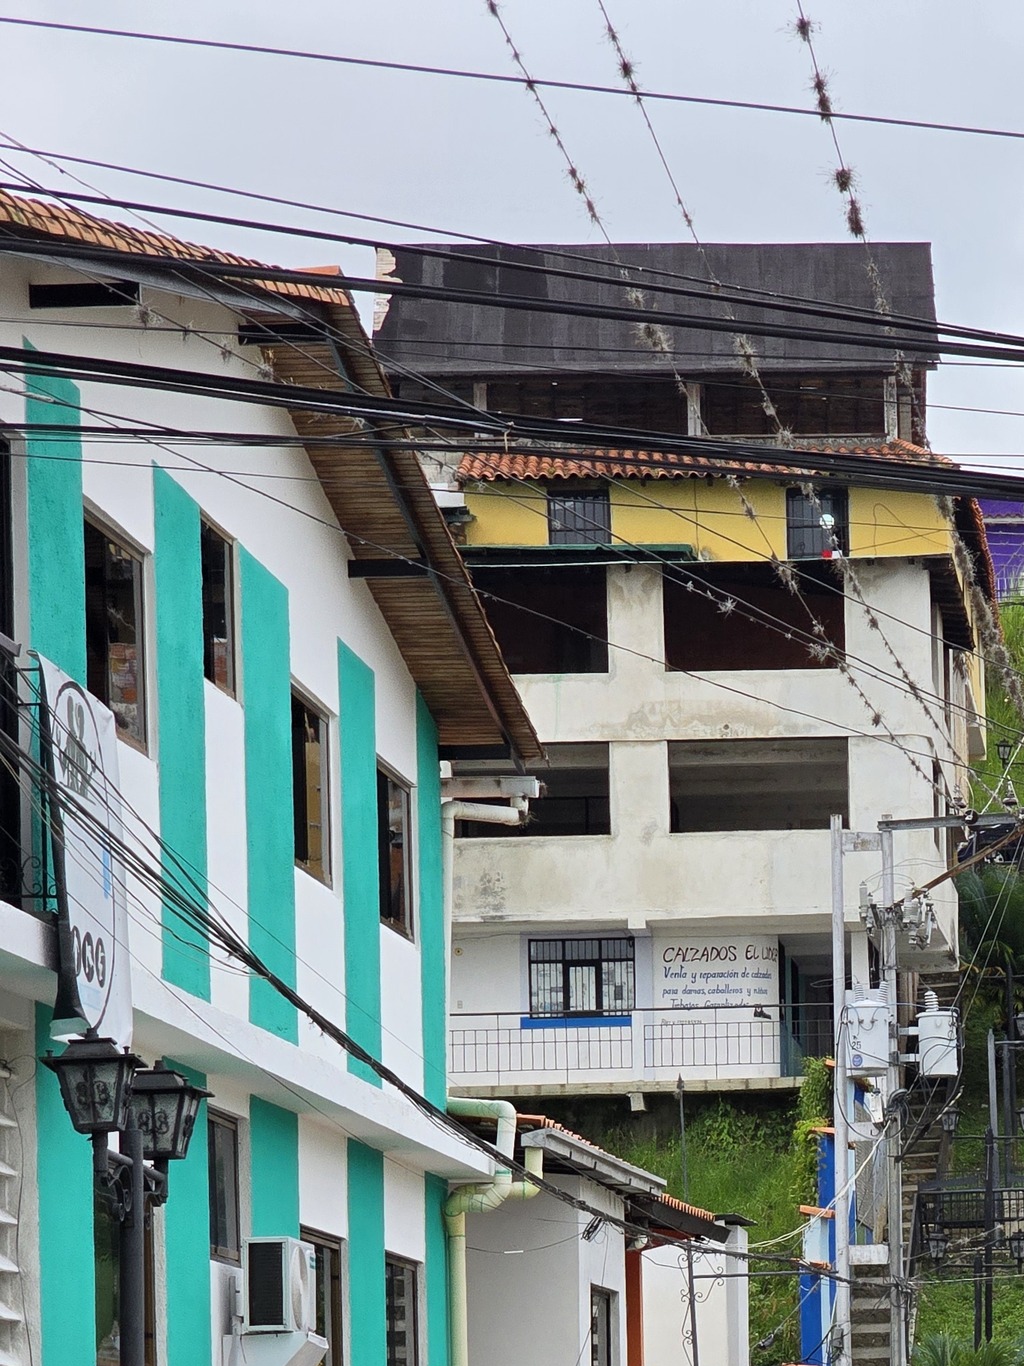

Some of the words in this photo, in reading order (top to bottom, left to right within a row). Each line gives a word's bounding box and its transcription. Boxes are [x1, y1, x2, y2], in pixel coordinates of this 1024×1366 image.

[663, 945, 737, 963] CALZADOS
[664, 965, 687, 979] Venta
[691, 972, 697, 984] y
[700, 969, 739, 984] reparación
[741, 966, 750, 978] de
[662, 988, 678, 998] para
[708, 984, 743, 995] caballeros
[747, 988, 751, 997] y
[852, 1041, 861, 1050] 25
